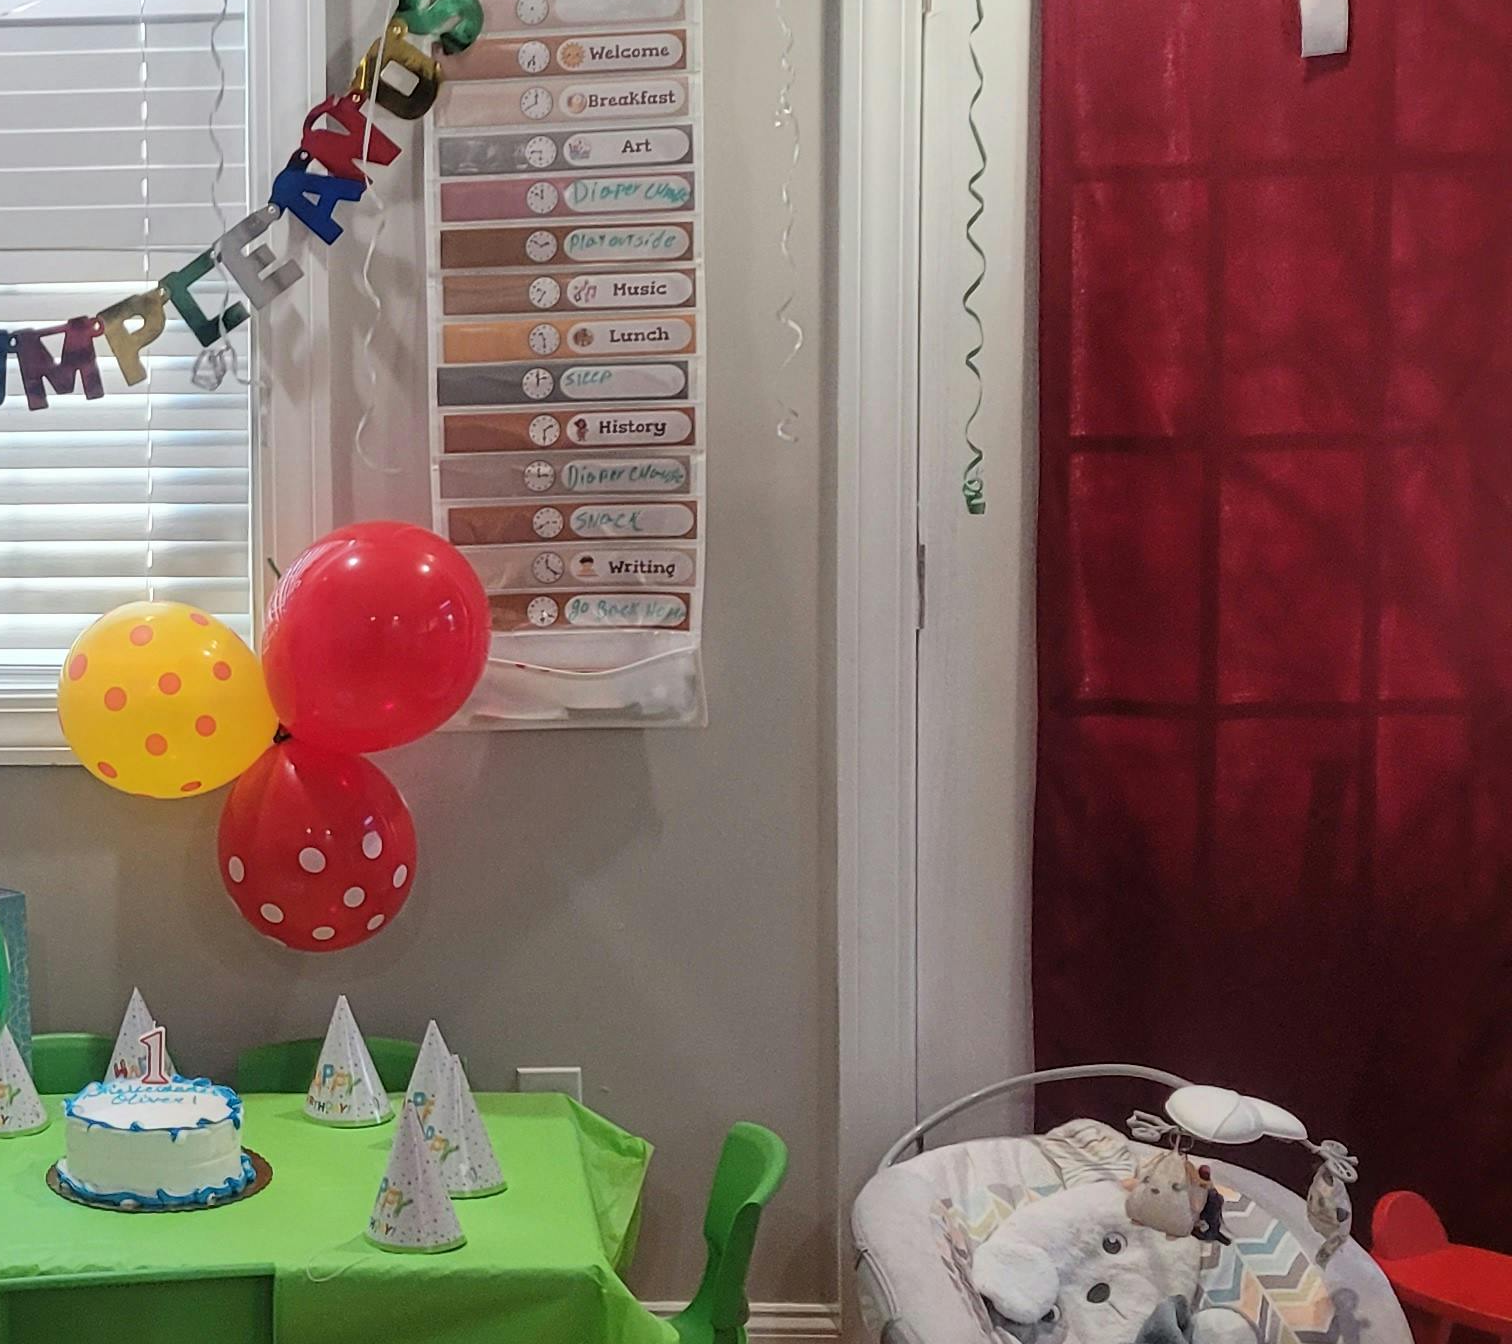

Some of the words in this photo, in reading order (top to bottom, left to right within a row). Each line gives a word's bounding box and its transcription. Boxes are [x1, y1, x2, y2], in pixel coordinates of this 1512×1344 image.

[589, 45, 670, 61] Welcome
[588, 90, 676, 108] Breakfast
[621, 138, 652, 153] Art
[612, 282, 668, 298] Music
[609, 327, 670, 344] Lunch
[599, 419, 667, 437] History
[608, 560, 676, 578] Writing
[140, 1026, 169, 1084] 1
